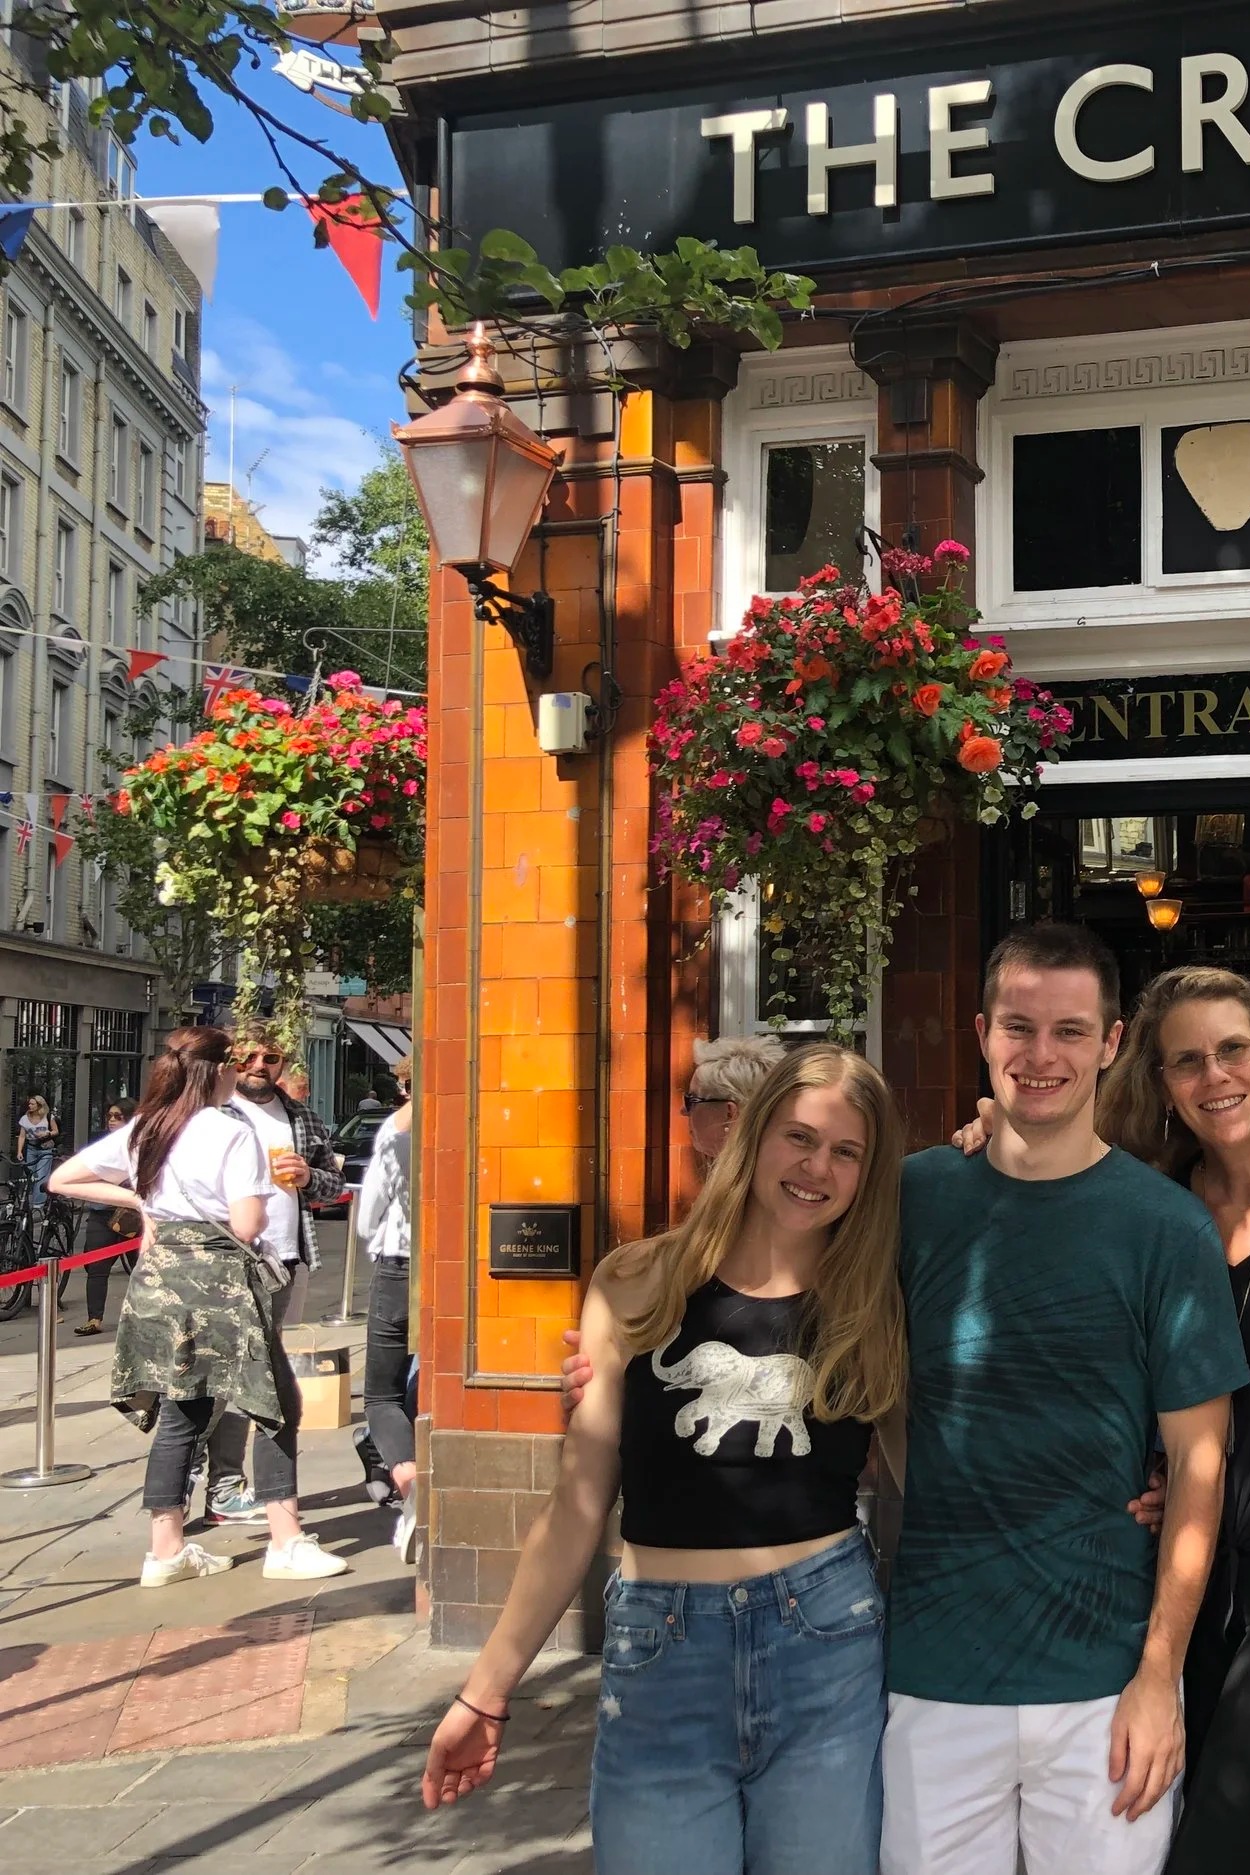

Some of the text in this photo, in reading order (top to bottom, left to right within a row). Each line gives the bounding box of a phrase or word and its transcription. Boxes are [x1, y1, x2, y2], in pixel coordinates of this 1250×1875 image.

[701, 80, 995, 224] THE
[500, 1244, 560, 1253] GREENE KING
